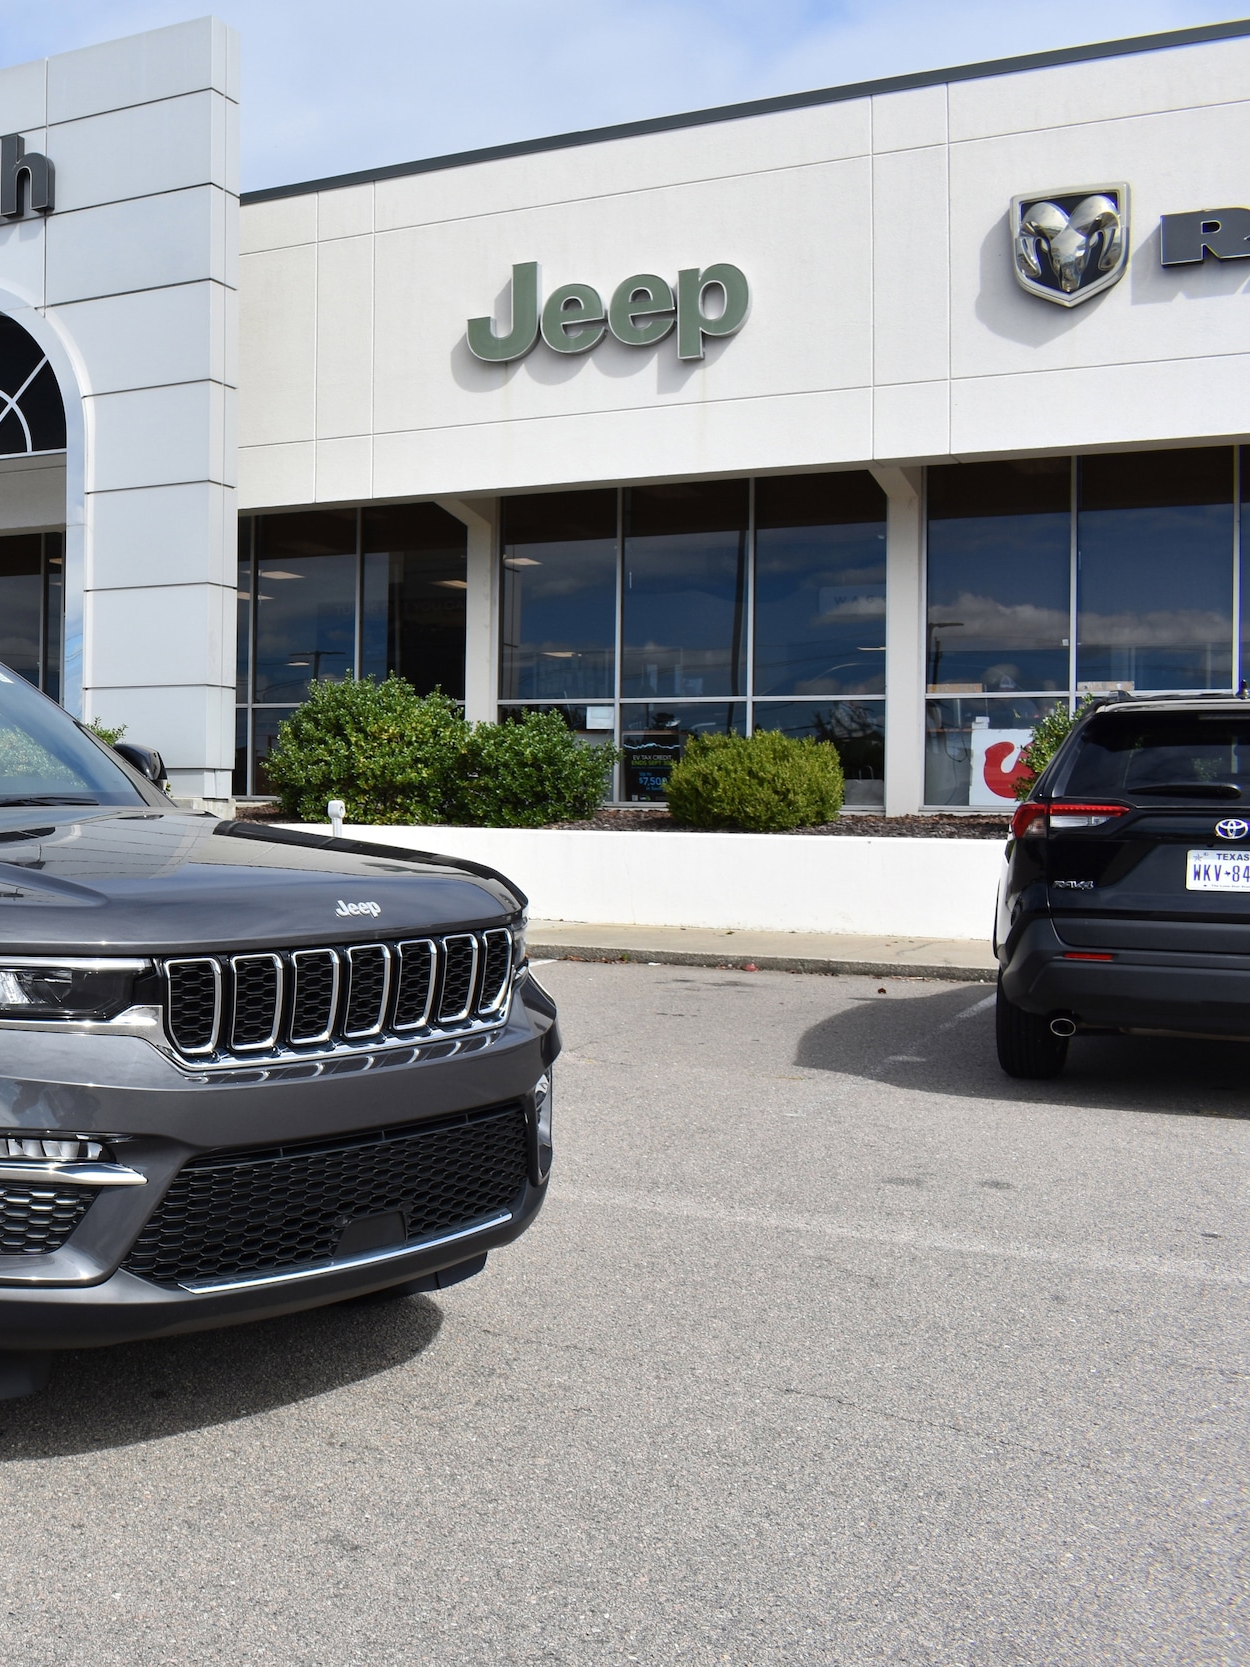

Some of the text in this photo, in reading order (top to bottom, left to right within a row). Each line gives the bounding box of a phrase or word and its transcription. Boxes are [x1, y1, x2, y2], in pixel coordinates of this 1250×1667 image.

[1160, 207, 1250, 266] R
[467, 261, 752, 361] Jeep
[834, 594, 886, 605] WAG
[1216, 853, 1250, 861] TEXAS
[335, 900, 381, 918] Jeep
